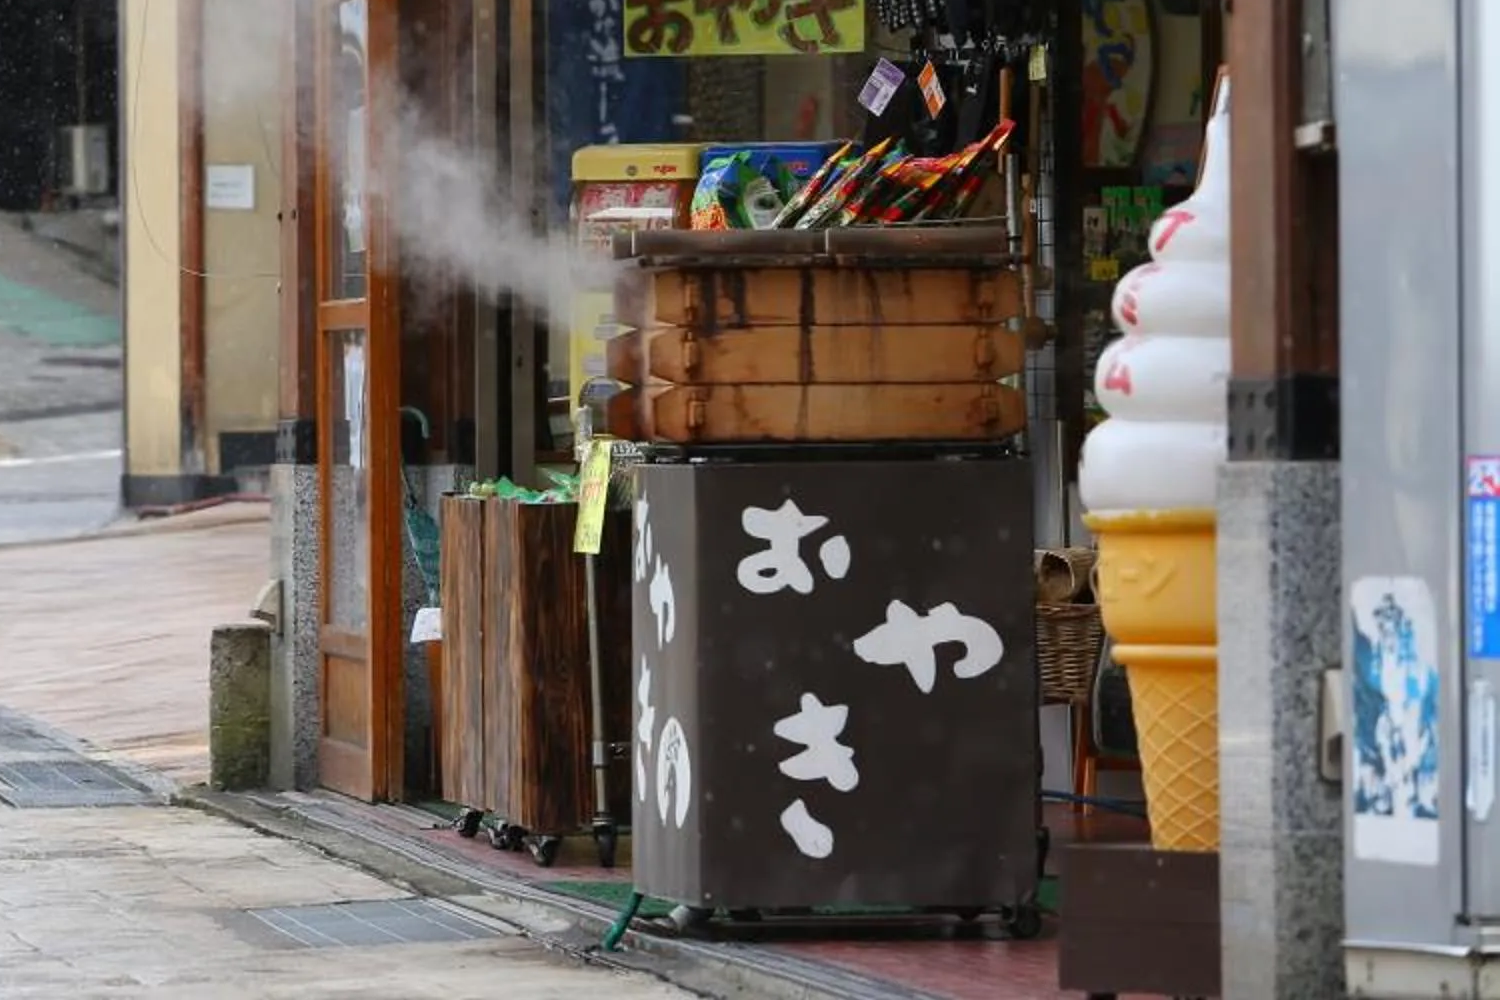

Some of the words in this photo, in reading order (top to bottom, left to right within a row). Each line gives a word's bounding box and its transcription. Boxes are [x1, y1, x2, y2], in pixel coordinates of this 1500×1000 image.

[633, 491, 675, 801] おやき
[736, 499, 1004, 858] おやき
